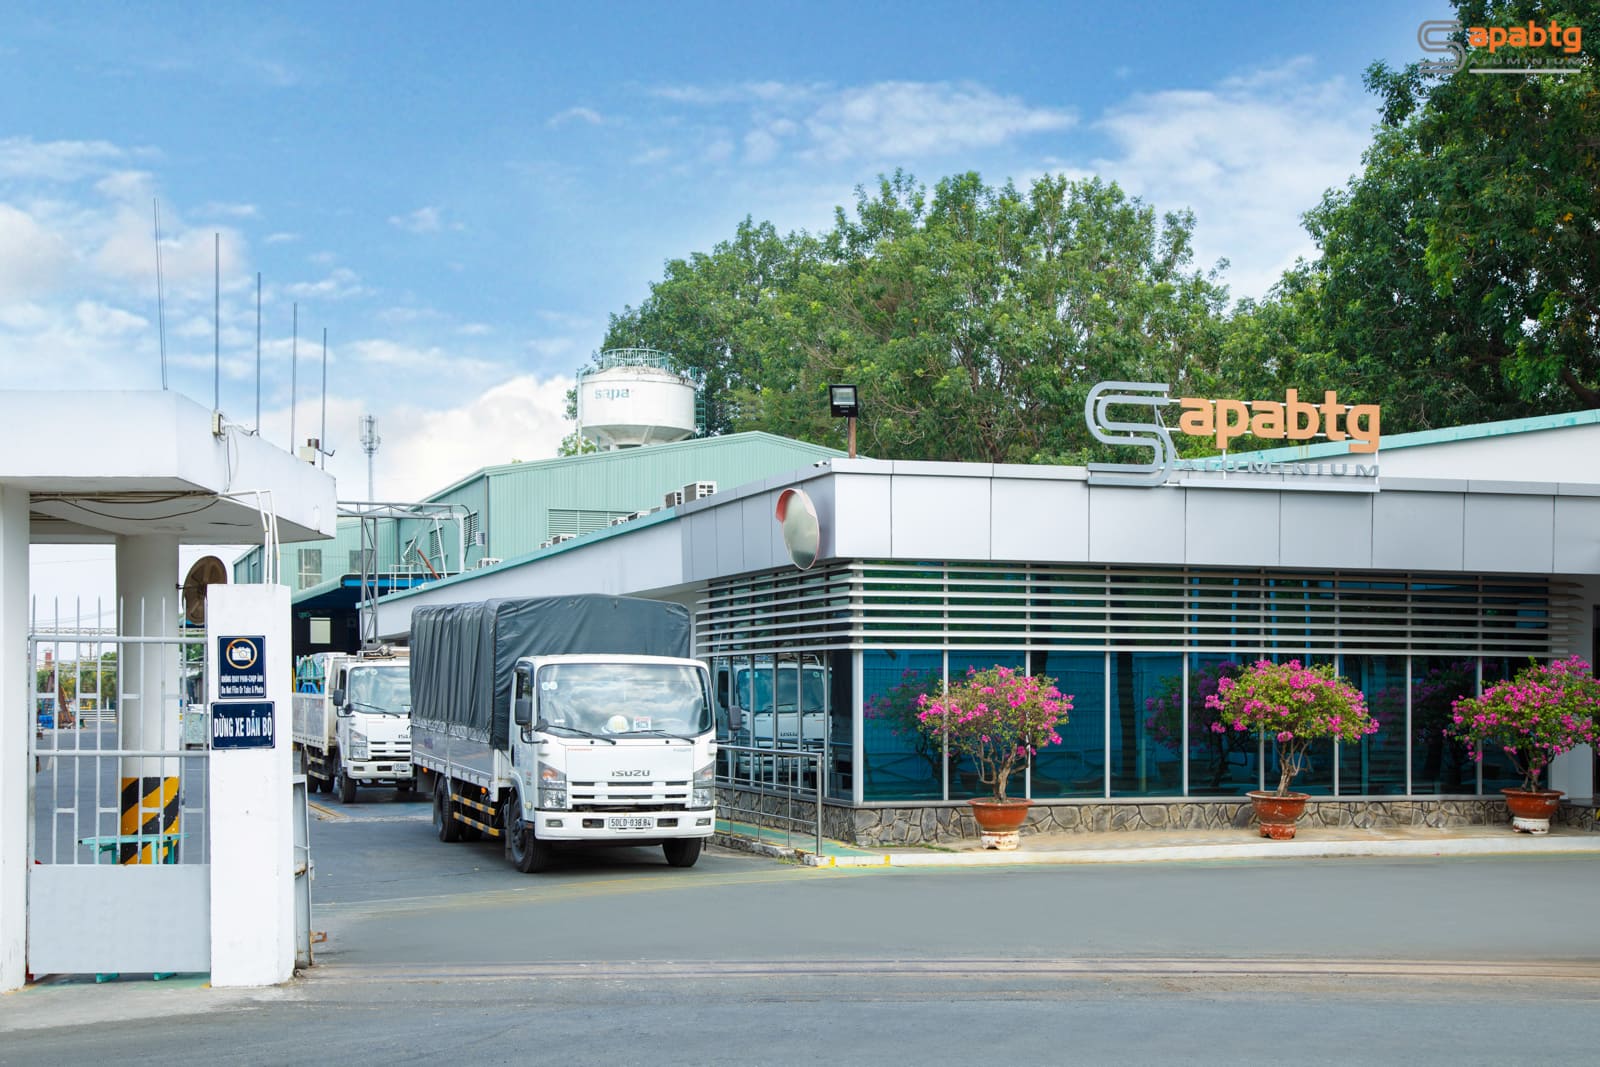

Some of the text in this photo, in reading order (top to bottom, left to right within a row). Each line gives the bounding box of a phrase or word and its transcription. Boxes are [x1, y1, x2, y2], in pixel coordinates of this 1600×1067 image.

[1181, 459, 1380, 478] ALUMINIUM
[235, 718, 245, 737] XE
[262, 712, 273, 741] BỘ
